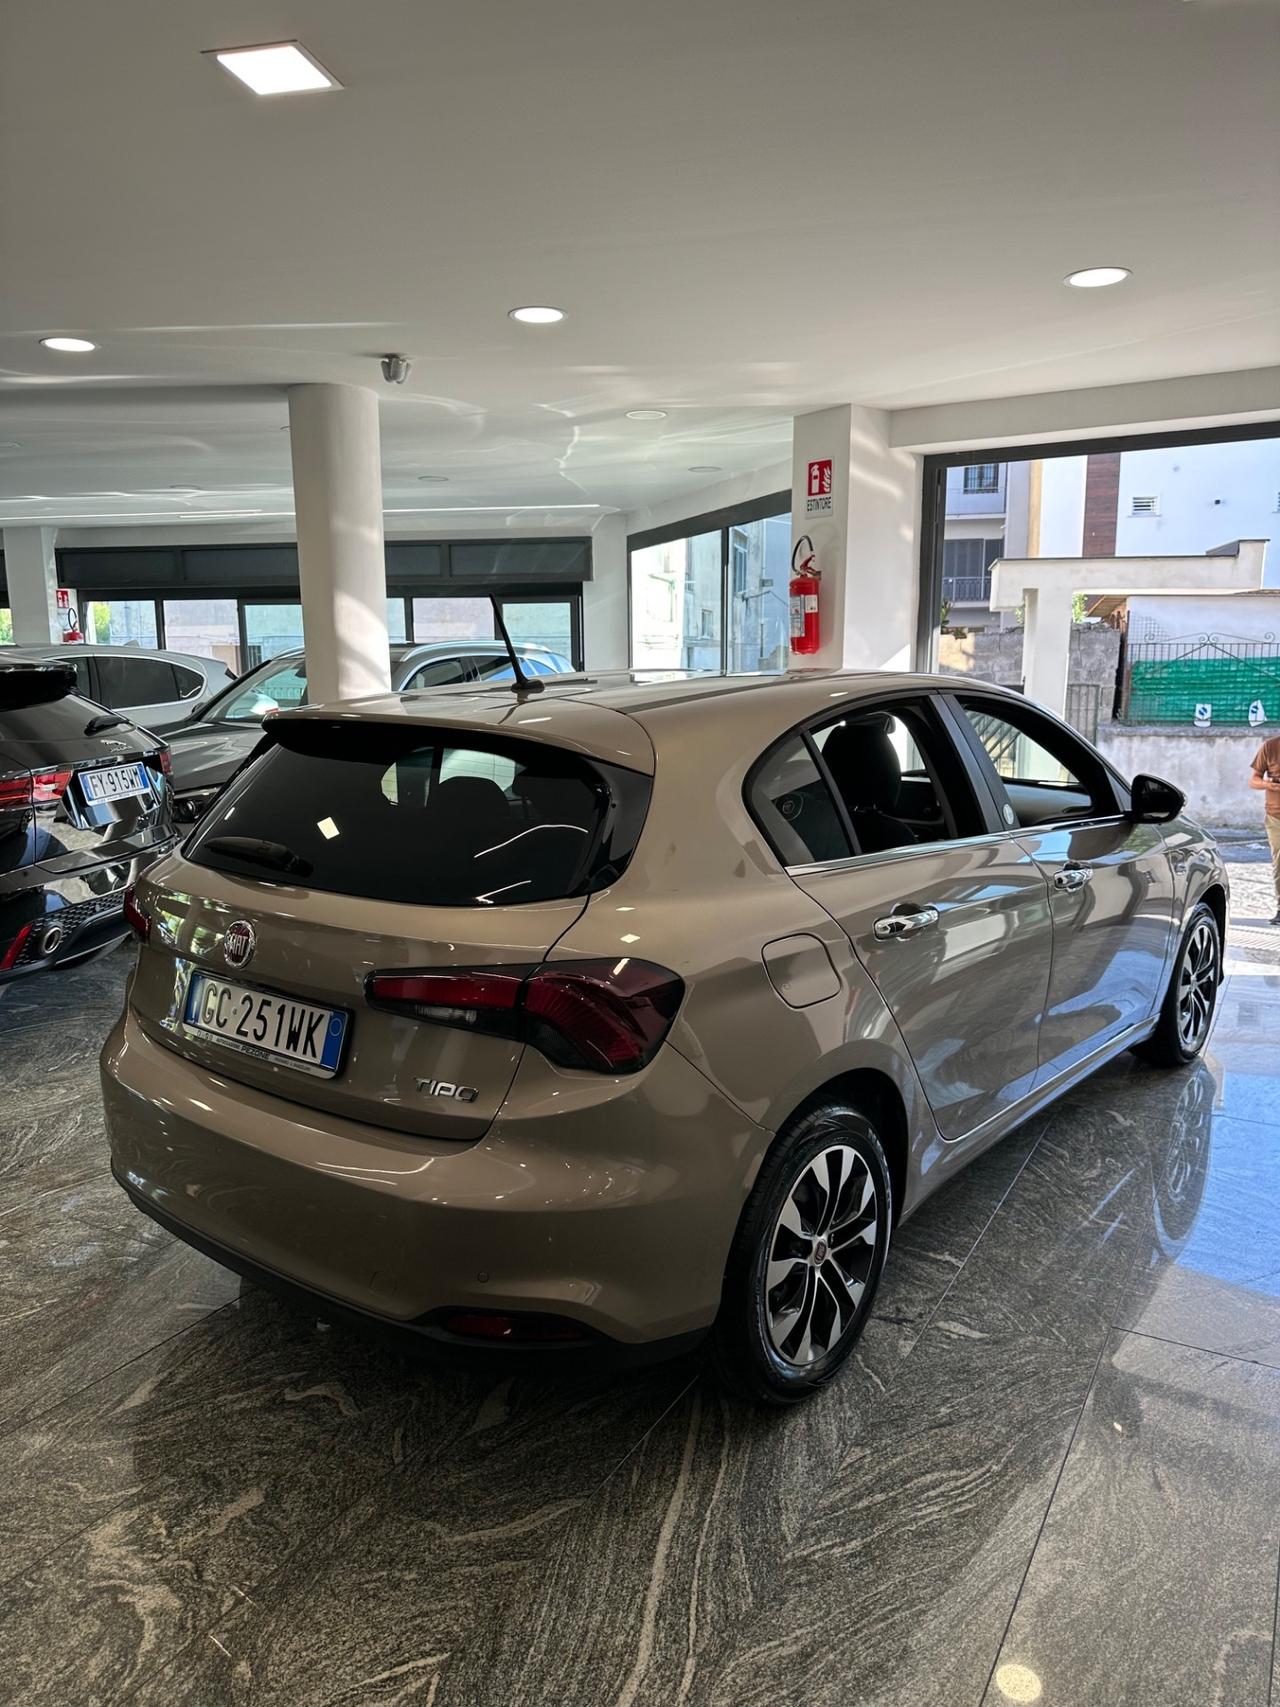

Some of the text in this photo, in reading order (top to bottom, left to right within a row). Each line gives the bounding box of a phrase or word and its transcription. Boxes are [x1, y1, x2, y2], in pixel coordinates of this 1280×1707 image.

[807, 496, 832, 511] ESTINTORE
[228, 932, 249, 956] FIAT
[416, 1078, 480, 1103] TIPO
